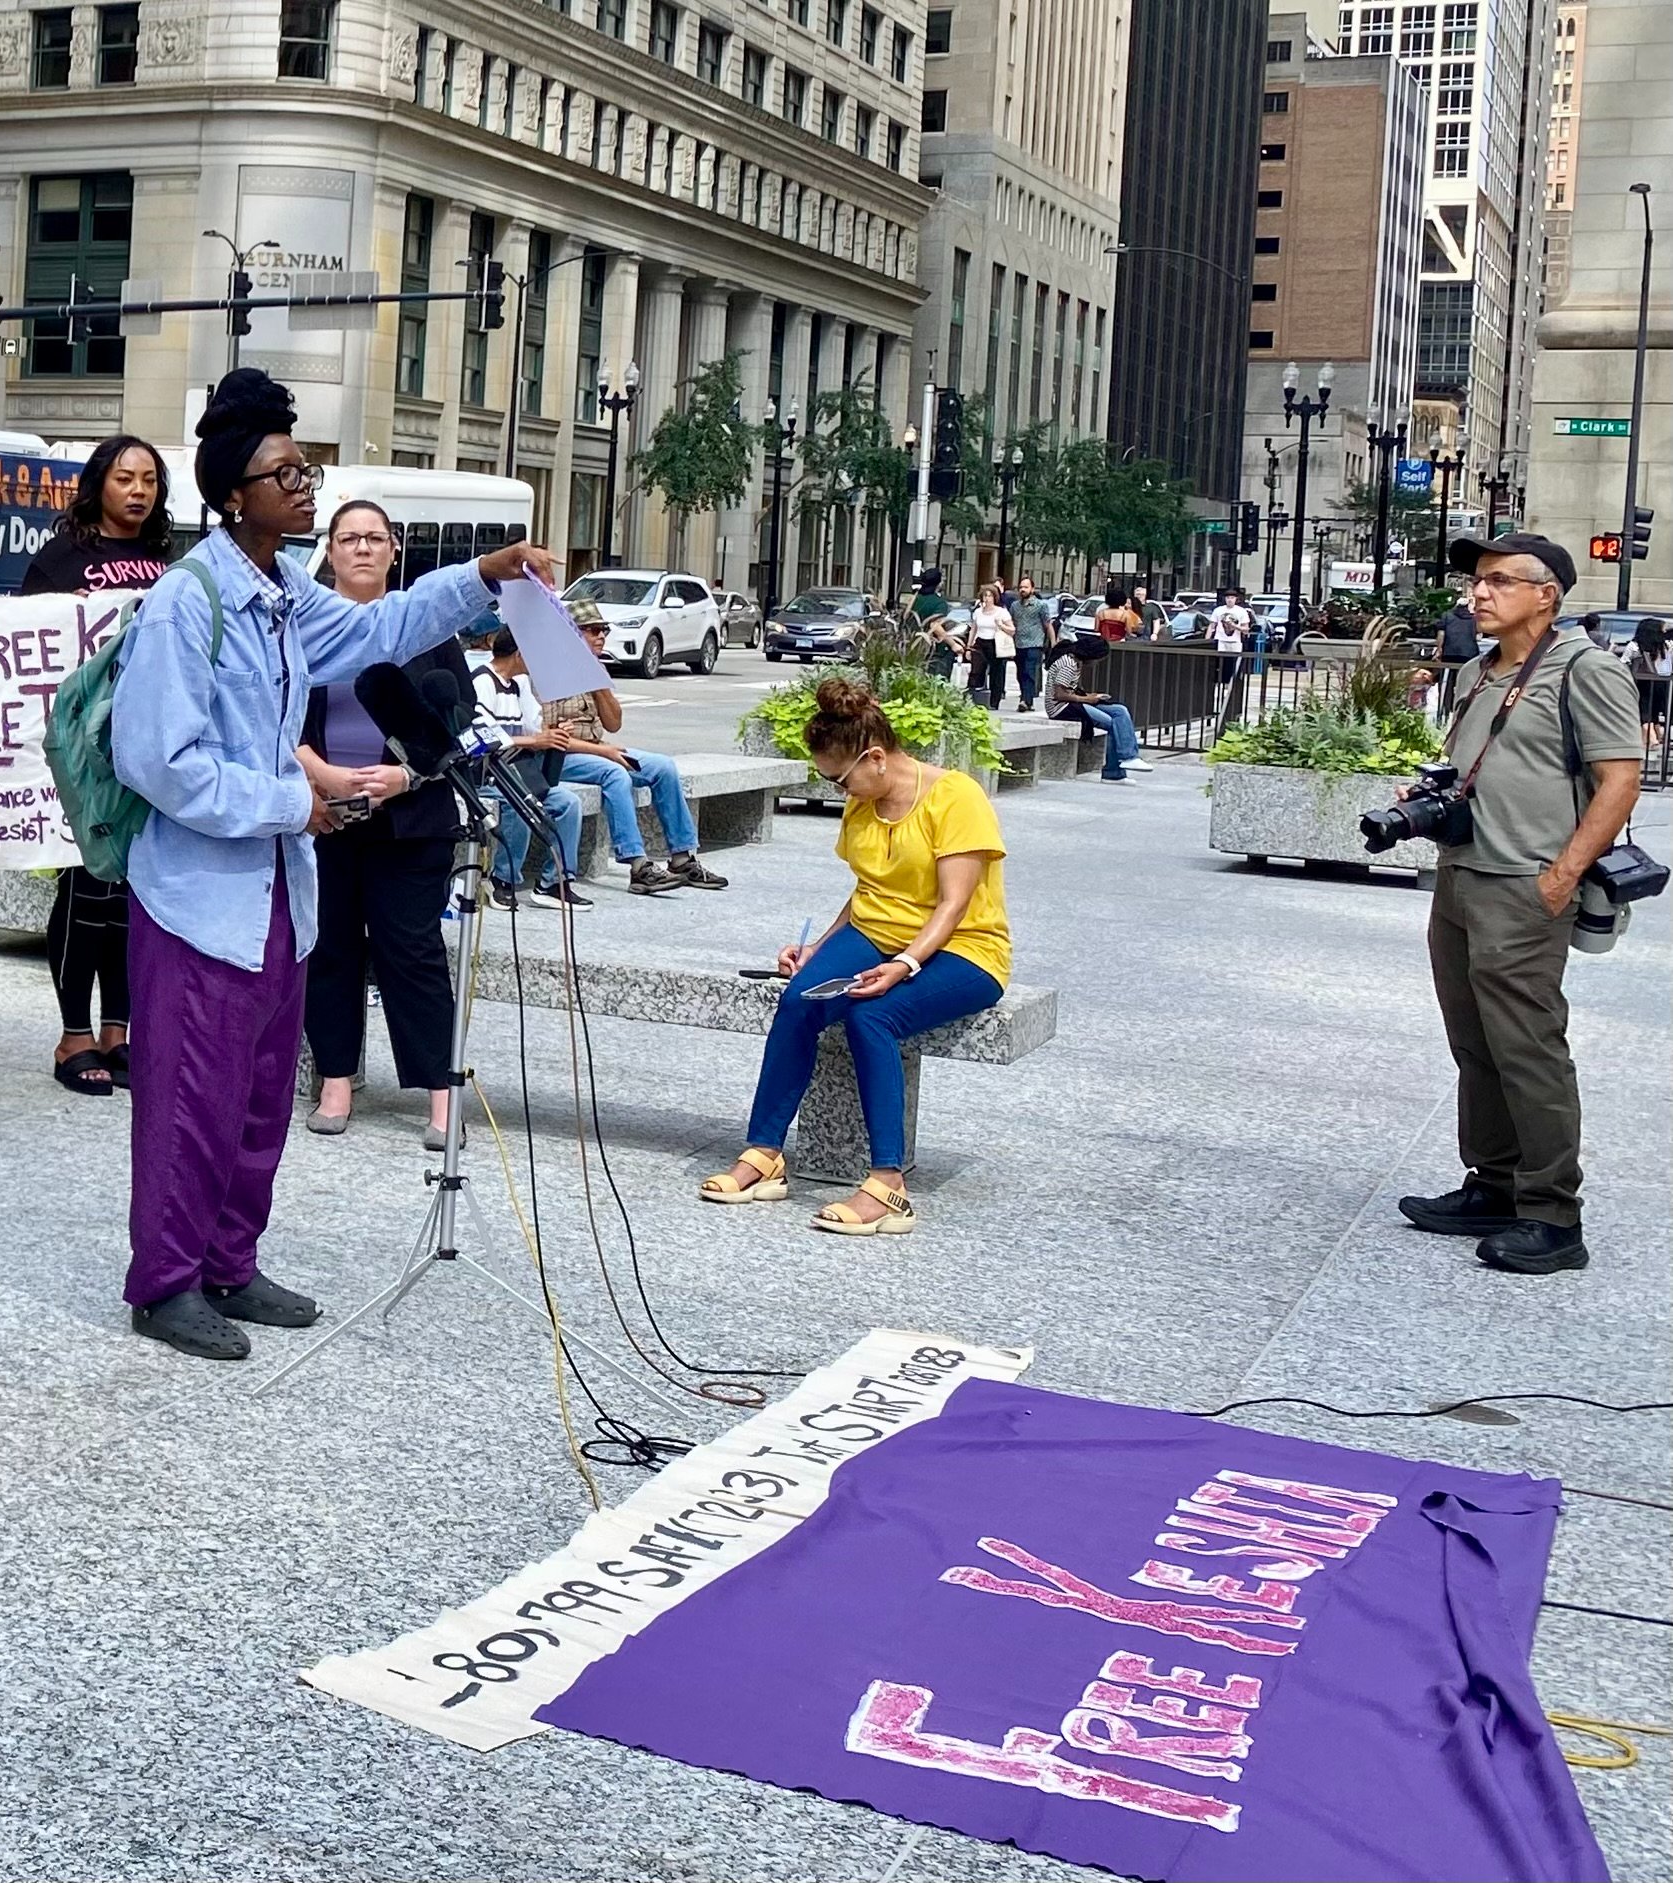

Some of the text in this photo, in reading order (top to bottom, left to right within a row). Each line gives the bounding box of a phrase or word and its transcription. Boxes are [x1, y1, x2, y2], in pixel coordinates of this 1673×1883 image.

[1580, 421, 1615, 432] Clark
[16, 464, 32, 508] &
[37, 466, 80, 511] Aut
[1401, 471, 1427, 481] Self
[83, 560, 167, 591] SURVIV
[844, 1469, 1398, 1833] FREE KESHIA
